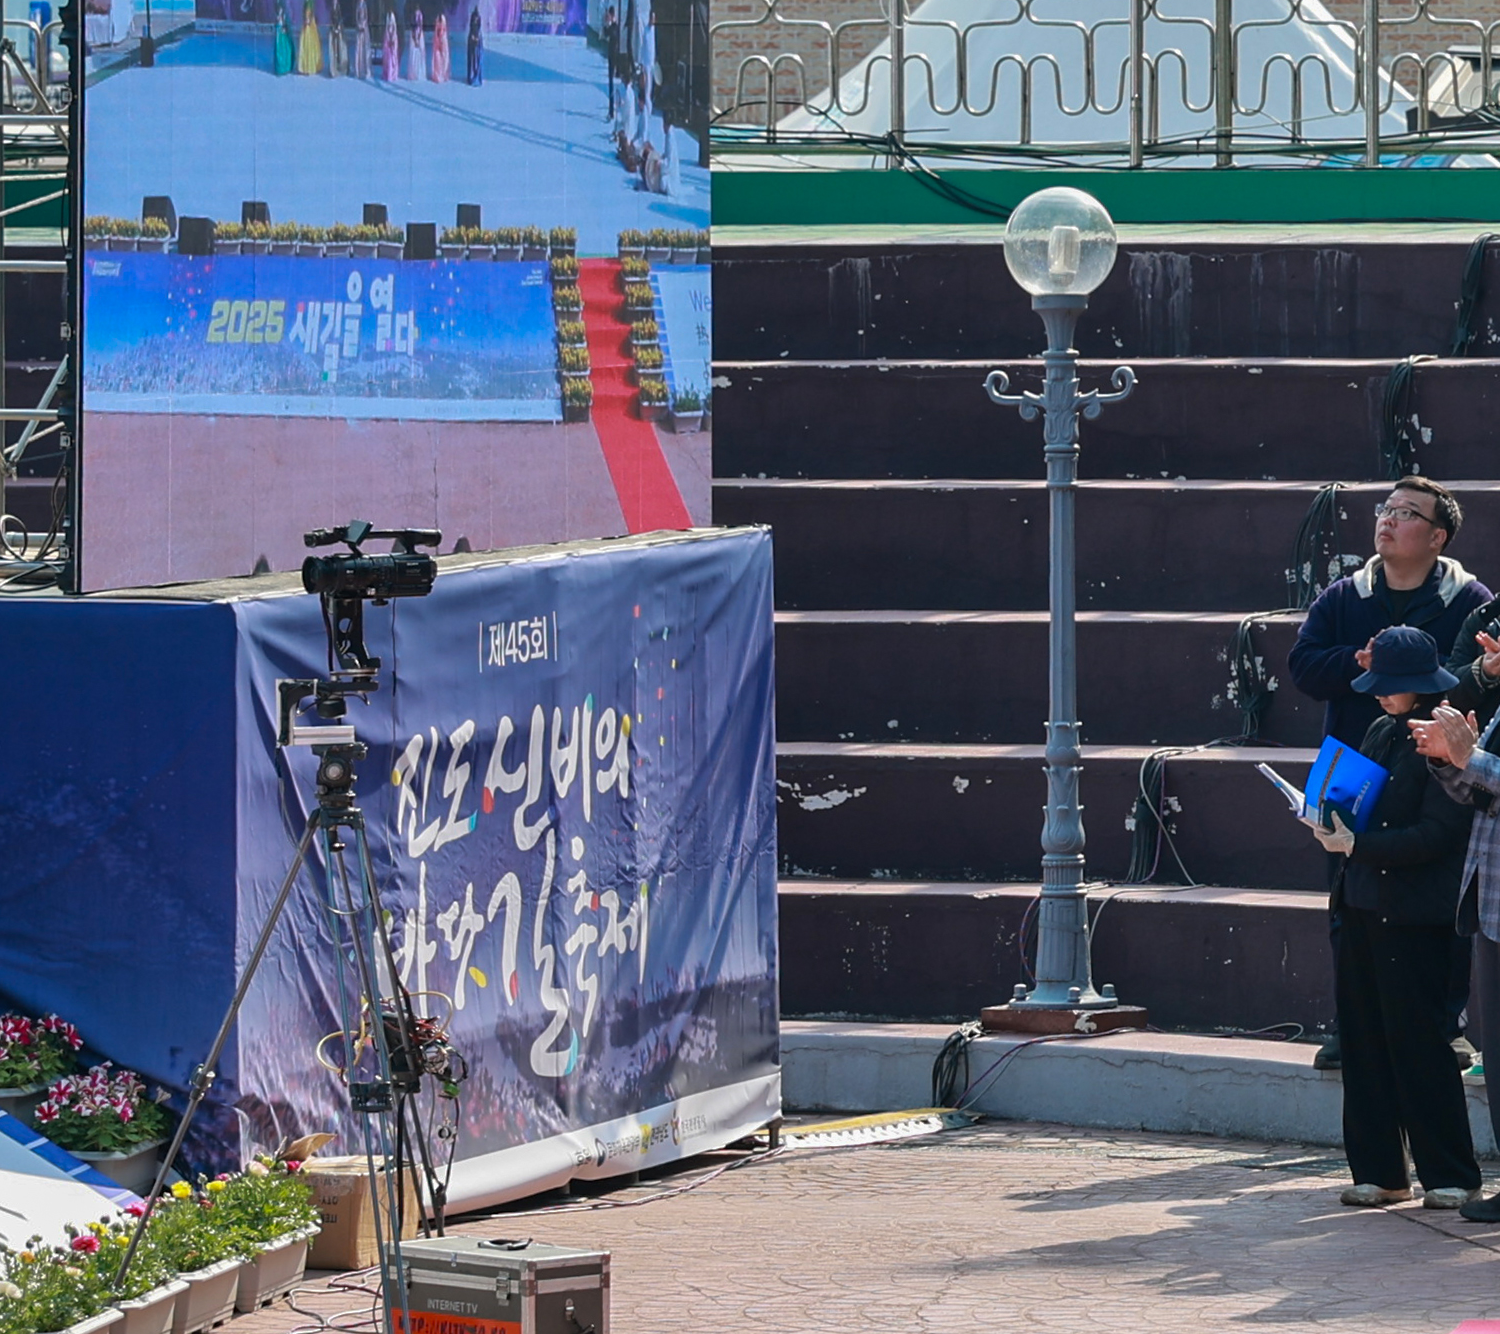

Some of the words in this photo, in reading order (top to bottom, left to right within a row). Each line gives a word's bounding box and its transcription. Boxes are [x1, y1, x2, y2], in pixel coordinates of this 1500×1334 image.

[207, 300, 286, 344] 2025
[289, 271, 363, 383] 새길을
[369, 273, 418, 357] 열다
[488, 618, 548, 667] 제45회
[391, 718, 479, 858] 진도
[482, 693, 632, 852] 신비의
[427, 1298, 466, 1314] INTERNET
[466, 1302, 479, 1314] TV
